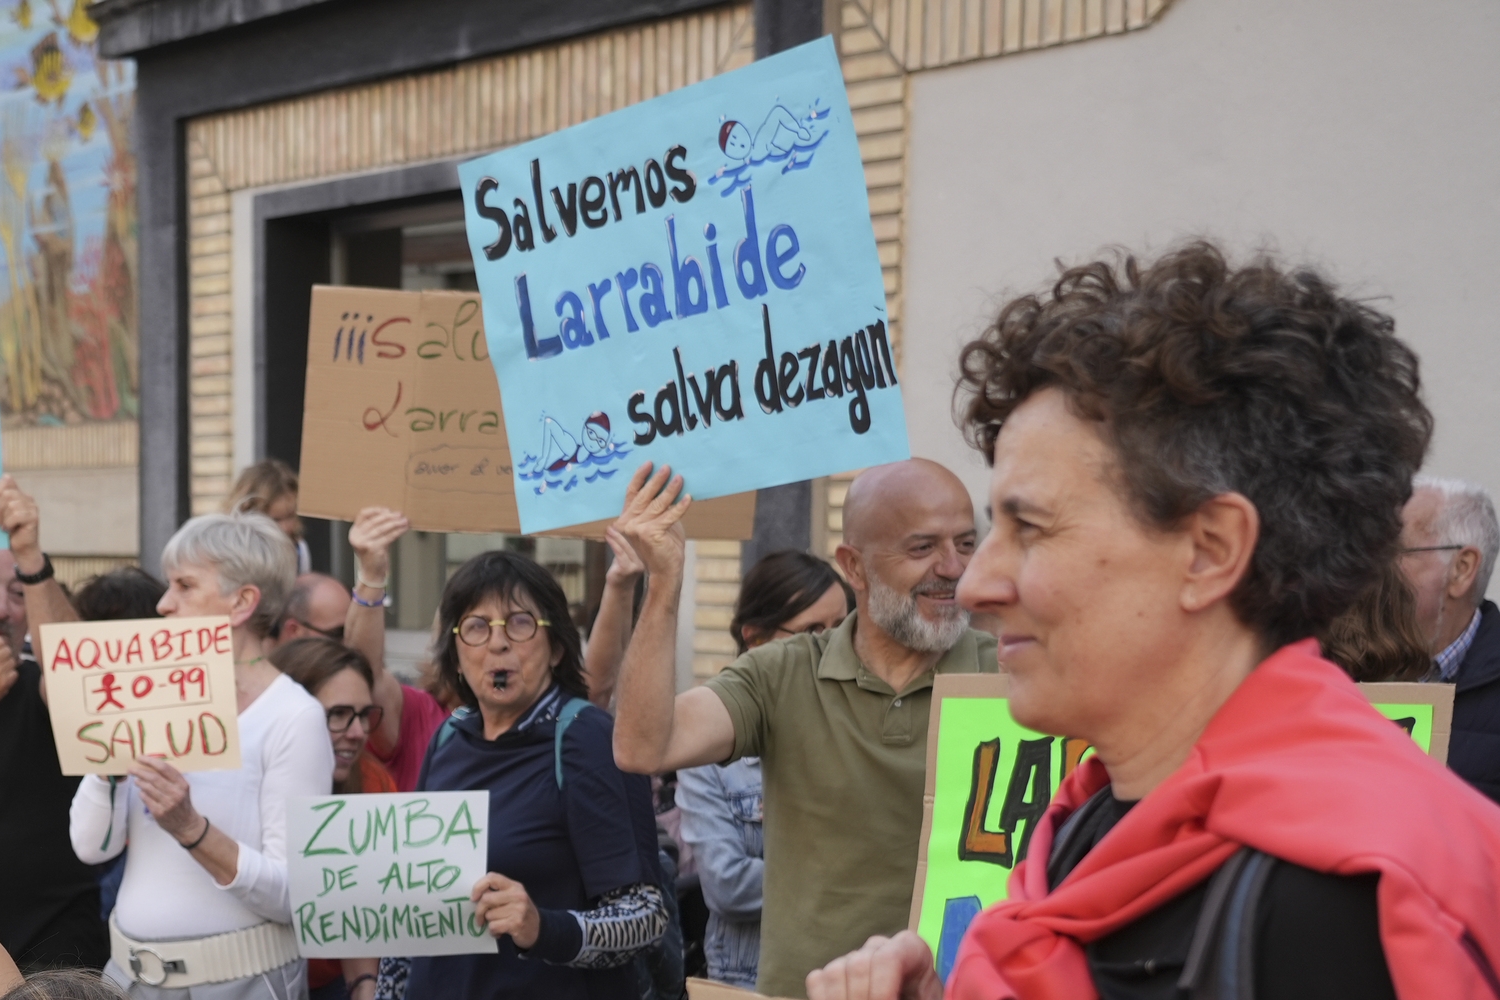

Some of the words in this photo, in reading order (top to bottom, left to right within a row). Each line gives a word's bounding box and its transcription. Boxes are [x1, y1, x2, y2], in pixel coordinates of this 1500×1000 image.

[475, 144, 697, 262] Salvemos
[514, 184, 807, 362] Larrabide
[626, 346, 746, 446] salva
[753, 303, 898, 435] dezagun
[131, 666, 206, 701] 0-99
[77, 712, 228, 764] SALUD
[299, 798, 482, 858] ZUMBA
[317, 865, 359, 897] DE
[377, 859, 462, 895] ALTO
